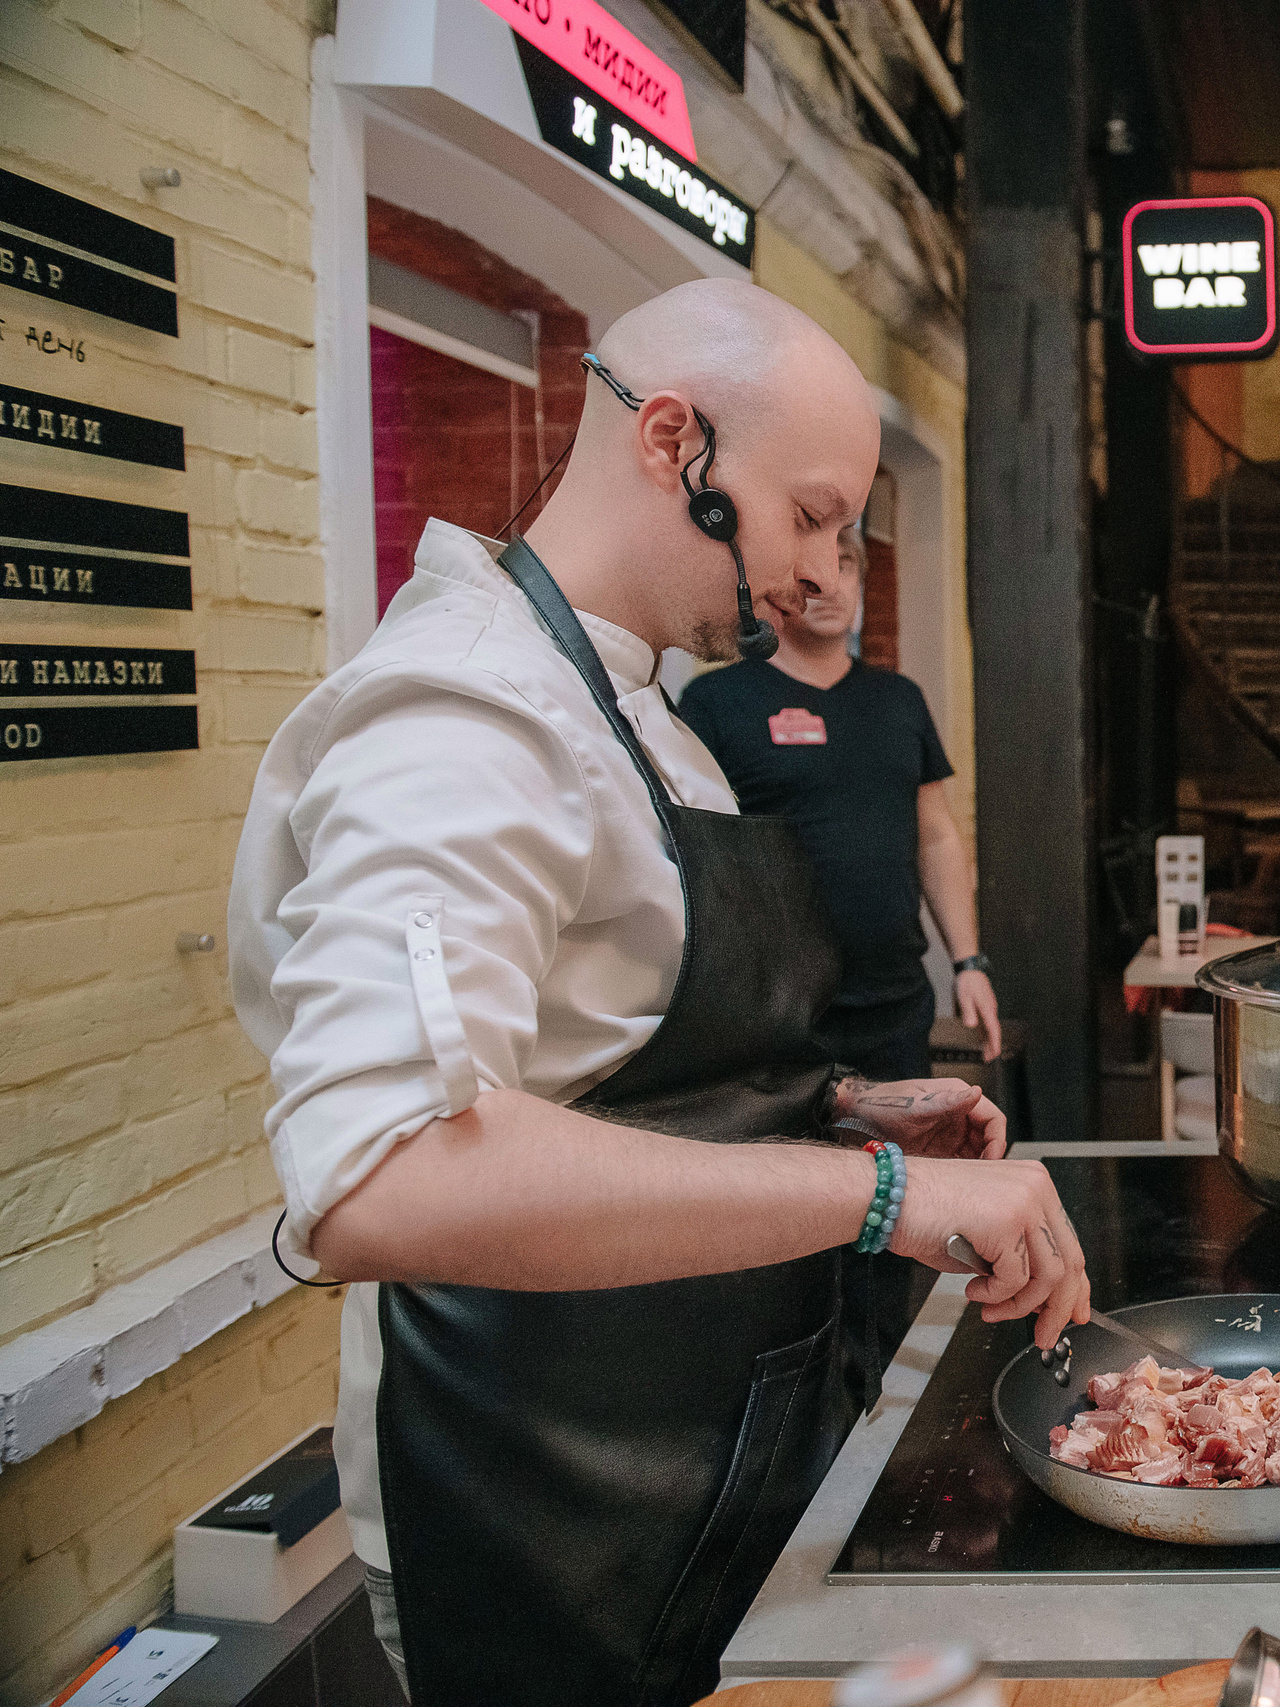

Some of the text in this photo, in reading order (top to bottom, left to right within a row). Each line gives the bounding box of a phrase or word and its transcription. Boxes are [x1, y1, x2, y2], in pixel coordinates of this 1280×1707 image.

[585, 26, 667, 115] МИДИИ
[572, 96, 598, 146] и
[0, 246, 63, 289] БАР
[1137, 240, 1261, 276] WINE
[1152, 275, 1248, 310] BAR
[3, 562, 94, 594] АЦИИ
[32, 659, 164, 686] НАМАЗКИ
